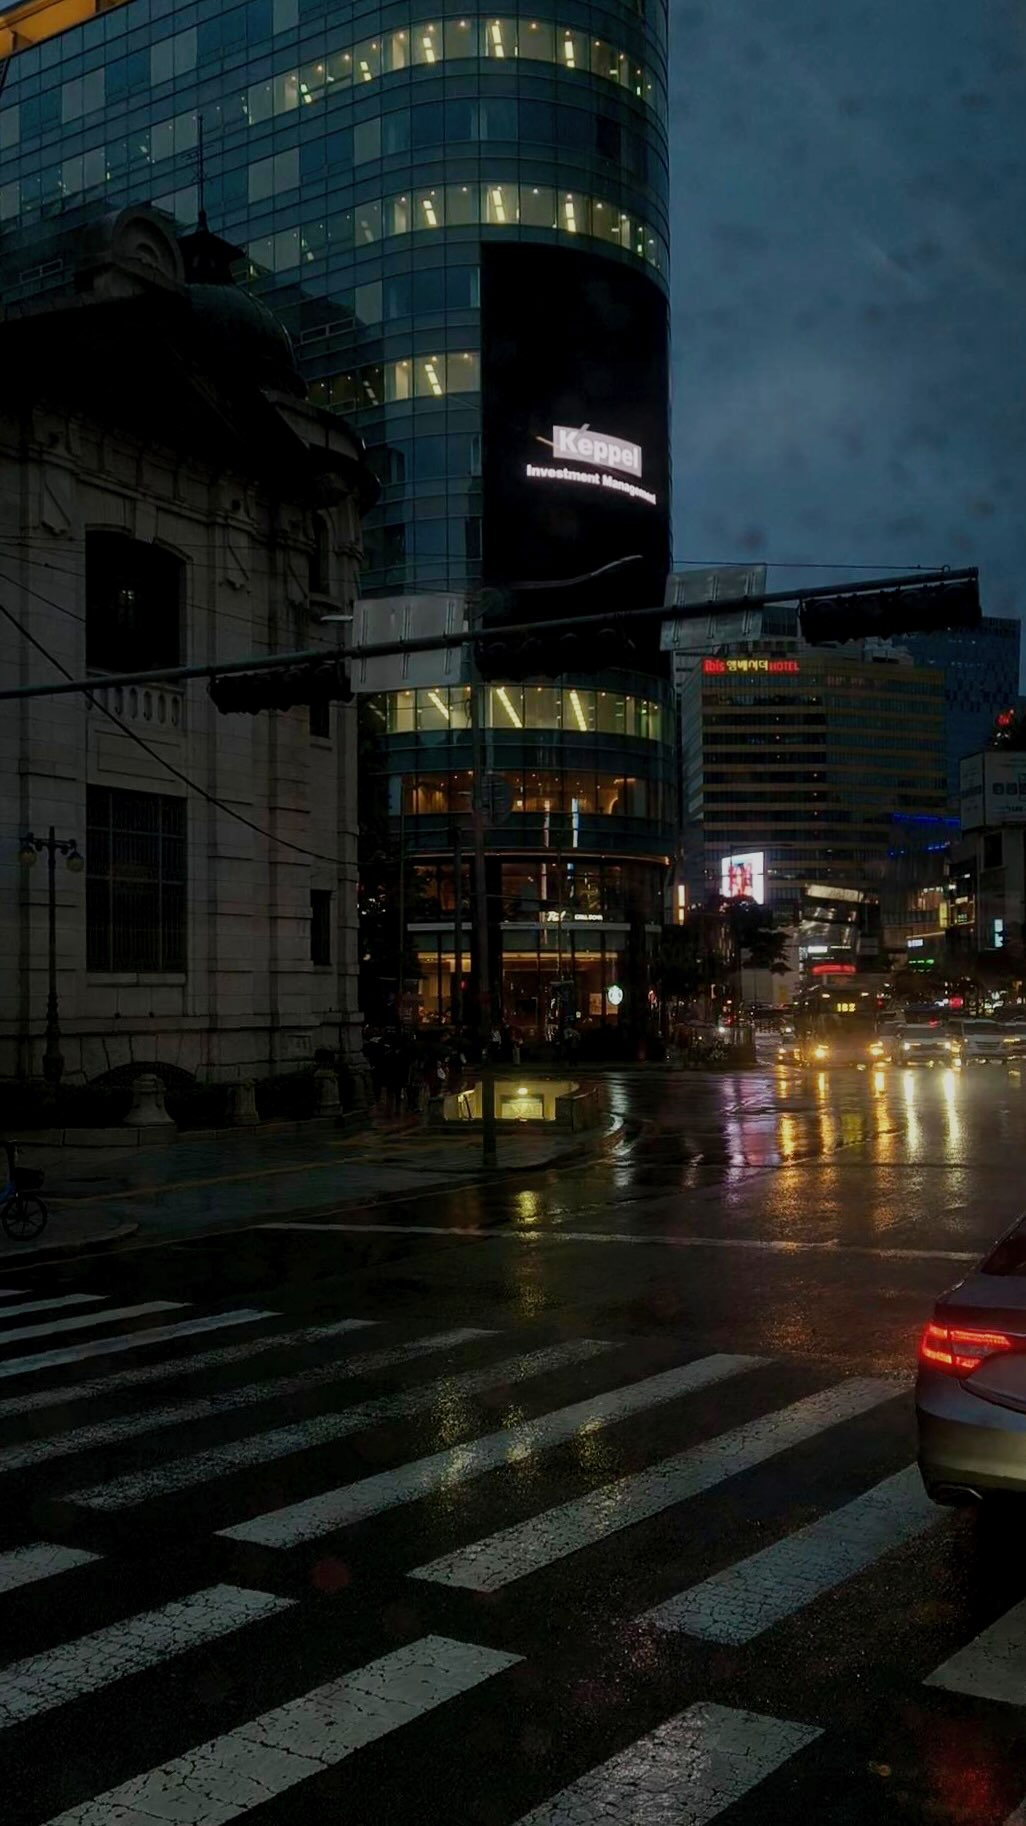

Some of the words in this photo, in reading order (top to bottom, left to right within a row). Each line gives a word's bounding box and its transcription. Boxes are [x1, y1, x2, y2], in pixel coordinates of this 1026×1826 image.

[559, 429, 639, 468] Keppel
[527, 464, 600, 484] Investment
[769, 660, 800, 672] HOTEL
